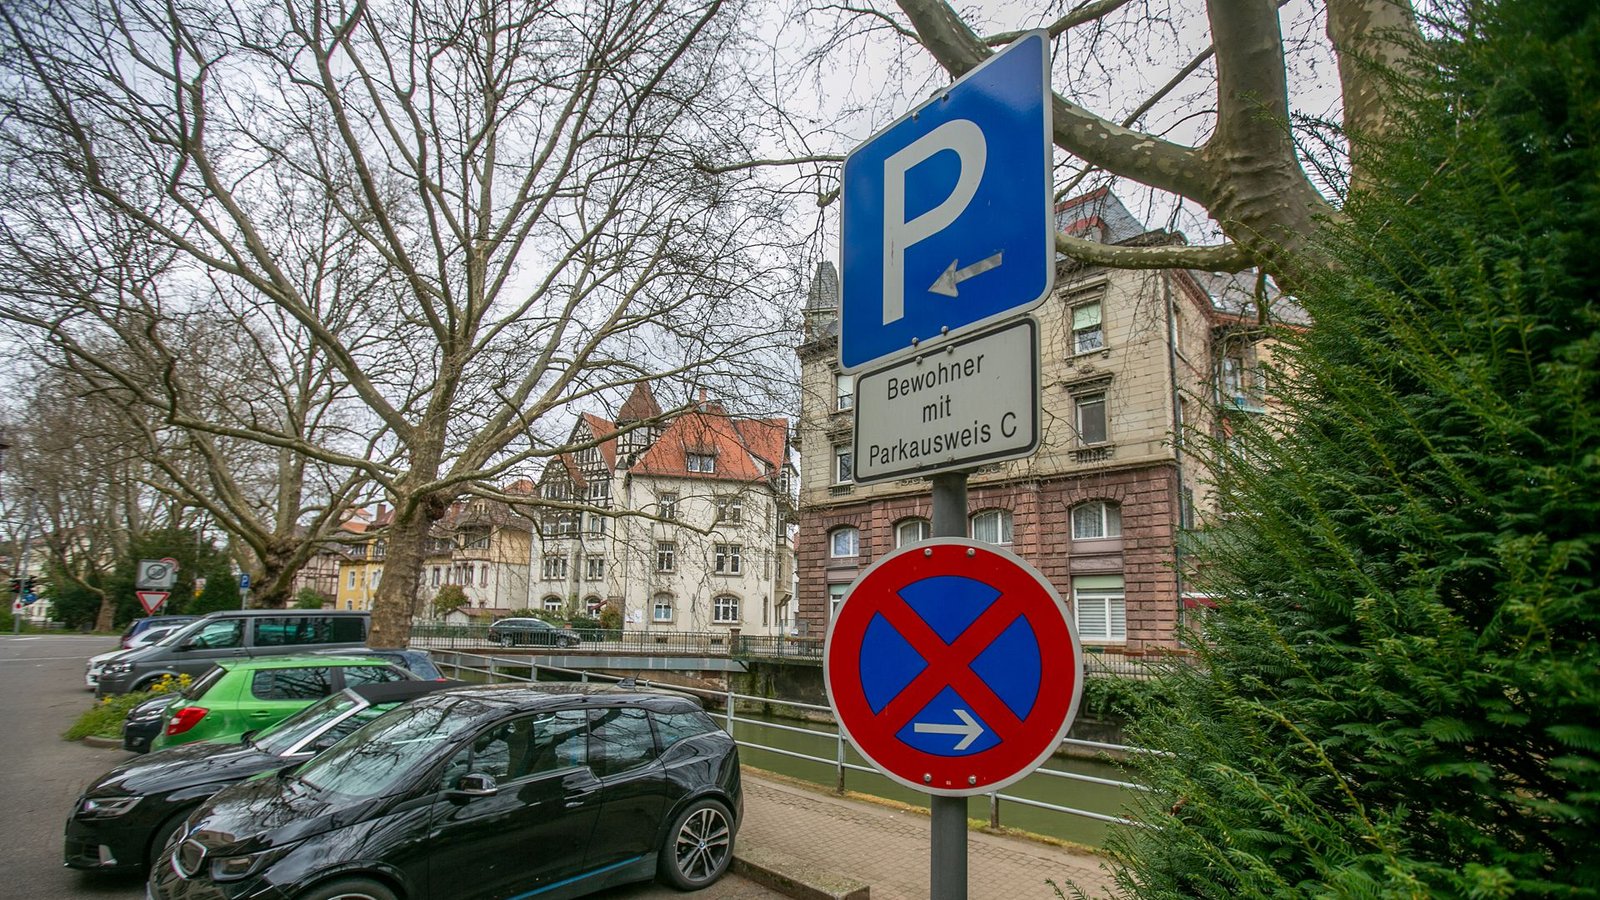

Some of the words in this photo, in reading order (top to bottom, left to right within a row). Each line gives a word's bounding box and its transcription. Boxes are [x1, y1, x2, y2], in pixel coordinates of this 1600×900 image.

[884, 118, 987, 326] P
[887, 354, 985, 400] Bewohner
[922, 396, 952, 423] mit
[869, 420, 992, 467] Parkausweis
[1001, 411, 1017, 438] C
